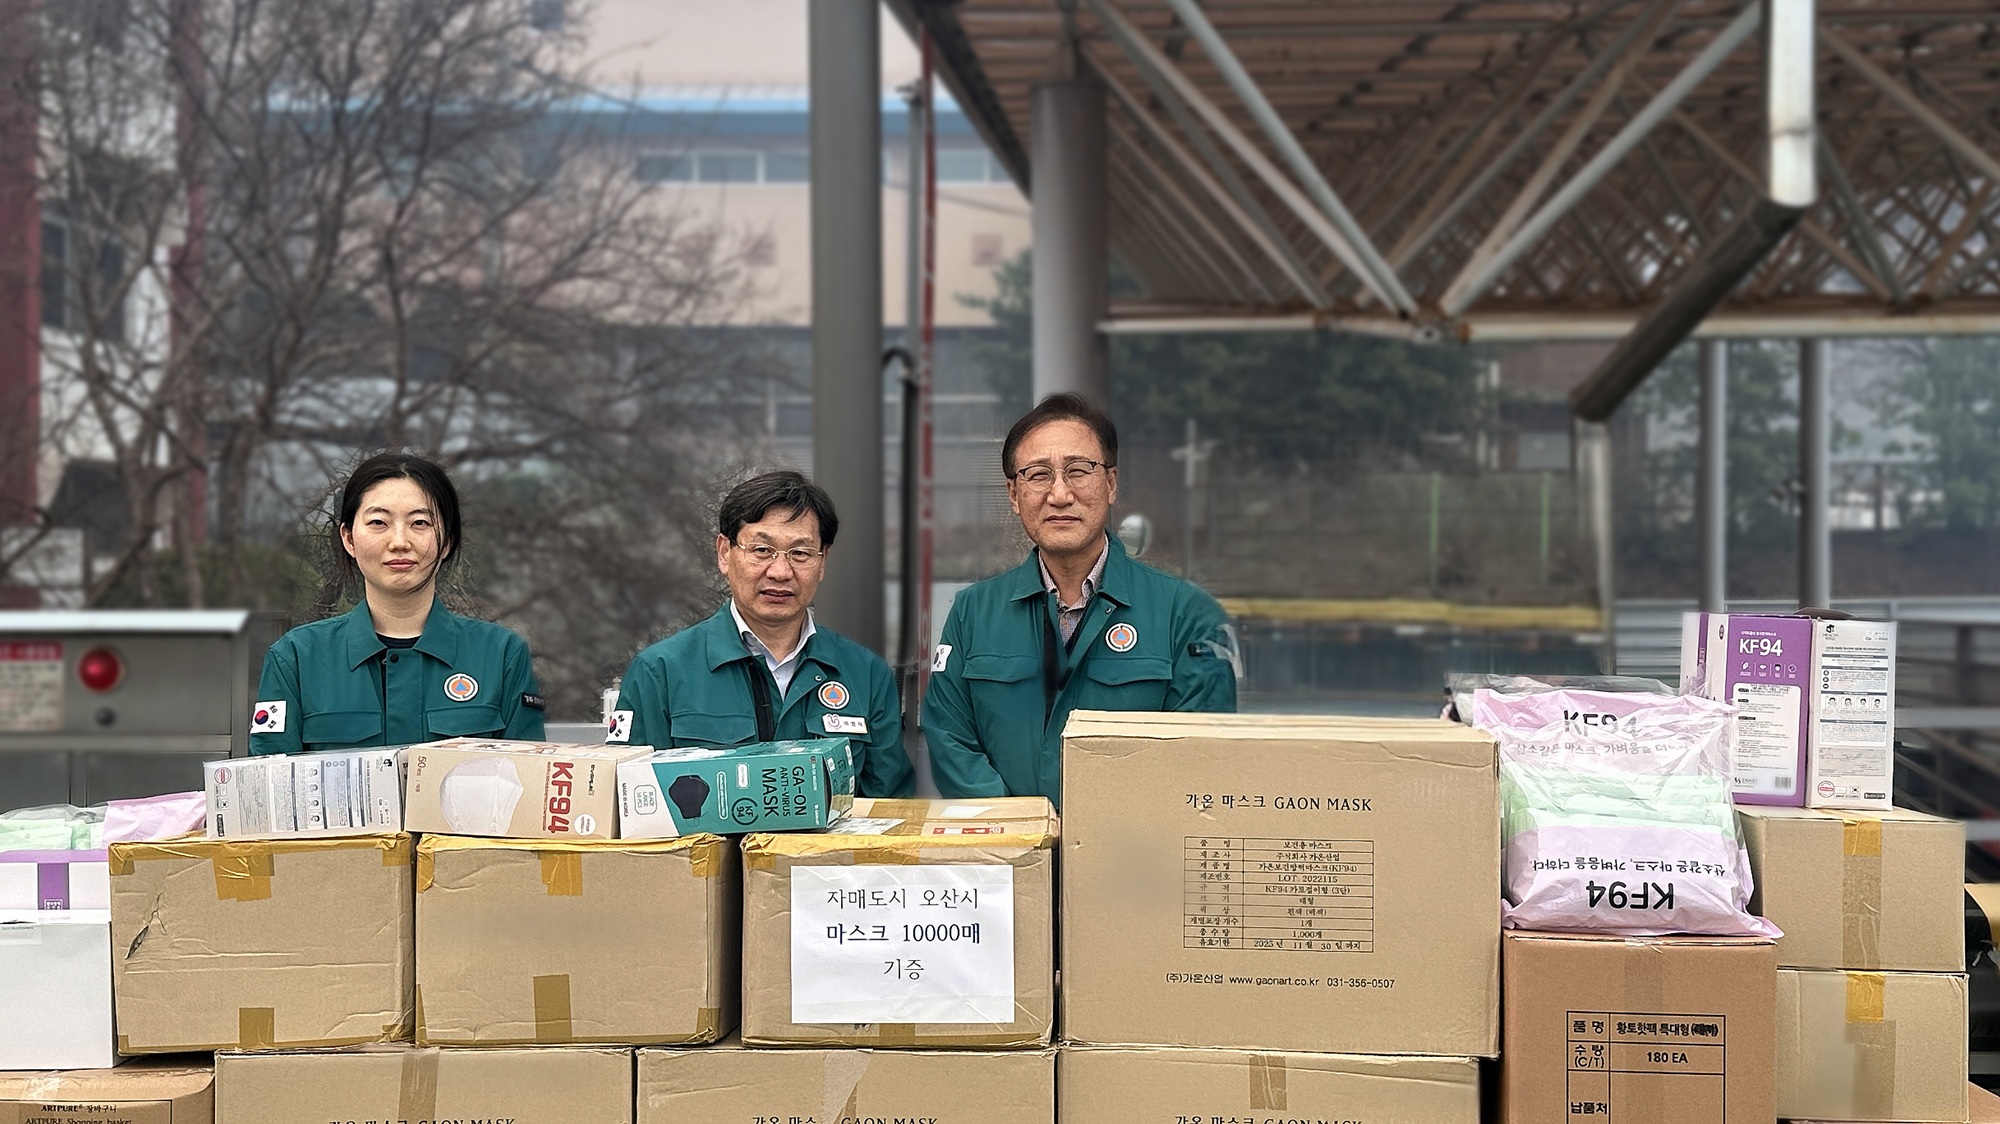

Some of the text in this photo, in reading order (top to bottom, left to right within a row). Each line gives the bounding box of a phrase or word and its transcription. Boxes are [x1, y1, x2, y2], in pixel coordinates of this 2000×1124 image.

[1739, 638, 1783, 656] KF94
[548, 761, 575, 834] KF94
[762, 768, 779, 817] MASK
[780, 766, 791, 817] ANTI-VIRUS
[792, 766, 807, 816] GA-ON
[1186, 794, 1372, 811] 가온 마스크 GAON MASK
[737, 806, 745, 817] 94
[745, 806, 754, 817] KF
[1574, 856, 1626, 871] 가벼움을
[1676, 861, 1725, 877] 산소같은
[1303, 875, 1338, 883] 2022115
[827, 888, 978, 910] 자매도시 오산시
[1585, 880, 1674, 909] KF94
[827, 922, 980, 945] 마스크 10000매
[883, 958, 925, 980] 기증
[1166, 973, 1395, 989] (주)가온산업 www.gaonart.co.kr 031-356-0507
[1617, 1022, 1657, 1036] 황토핫팩
[1660, 1023, 1689, 1036] 특대형
[1575, 1056, 1604, 1068] (C/T)
[1647, 1051, 1688, 1063] 180 EA
[1571, 1102, 1607, 1115] 납품처
